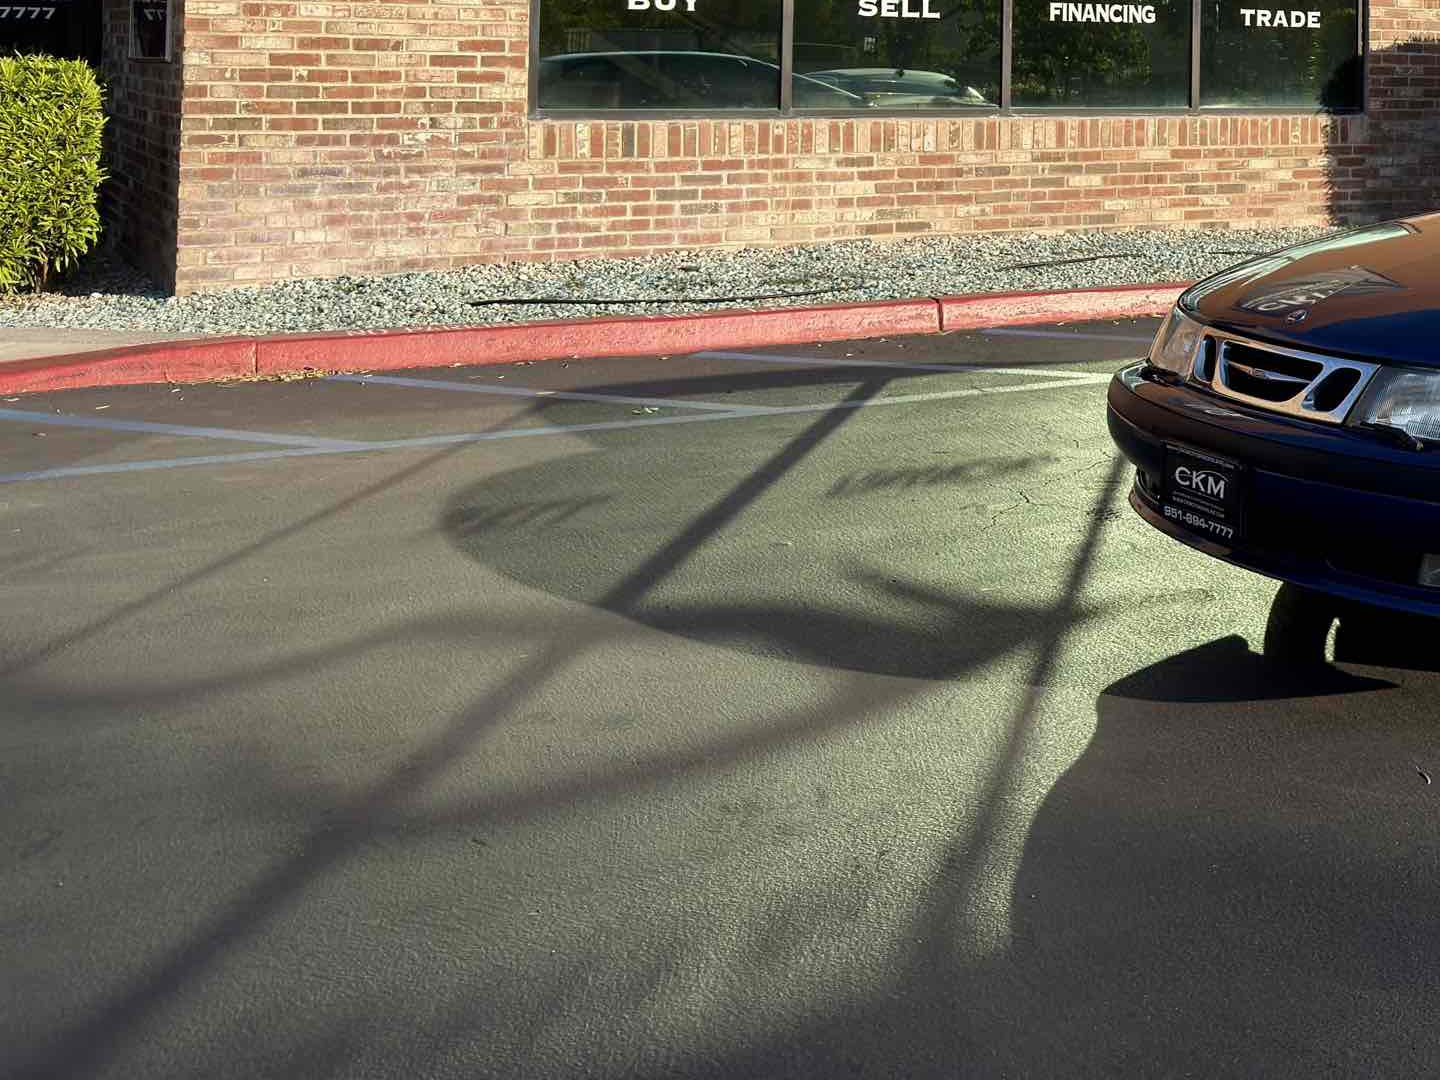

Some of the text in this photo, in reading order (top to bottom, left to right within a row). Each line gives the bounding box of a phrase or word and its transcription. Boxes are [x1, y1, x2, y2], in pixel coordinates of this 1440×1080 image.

[1049, 2, 1157, 25] FINANCING
[1240, 8, 1322, 29] TRADE
[1175, 466, 1225, 500] CKM
